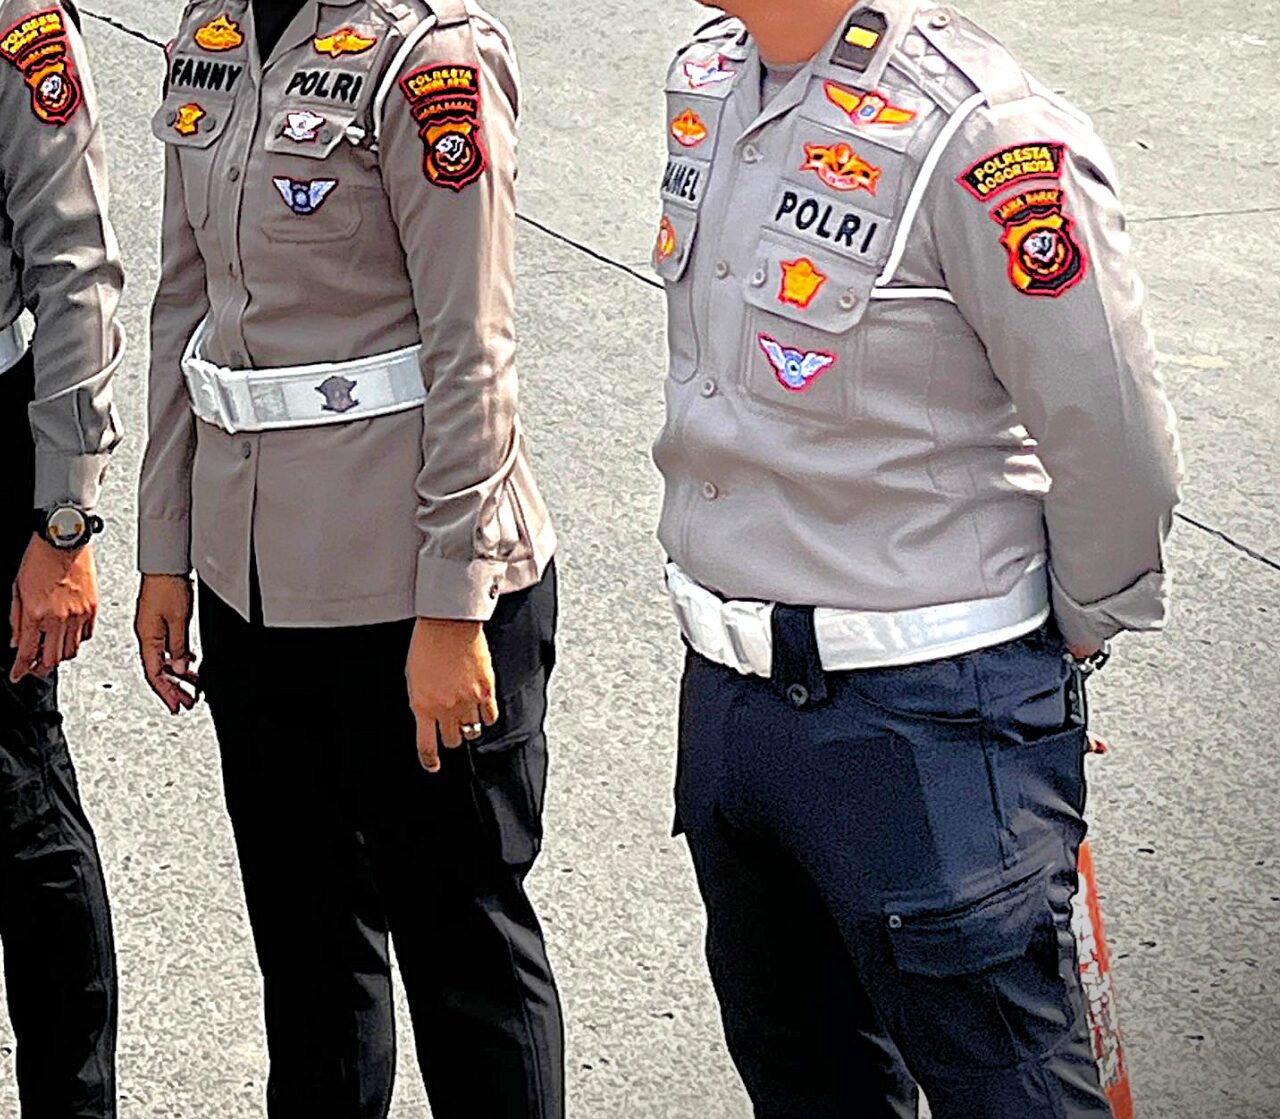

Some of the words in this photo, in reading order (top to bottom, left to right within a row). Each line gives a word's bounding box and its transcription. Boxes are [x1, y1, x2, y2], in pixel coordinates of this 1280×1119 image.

[170, 57, 243, 92] FANNY
[284, 70, 364, 105] POLRI
[974, 147, 1052, 182] POLRESTA
[977, 164, 1022, 194] BOGOR
[774, 190, 878, 254] POLRI
